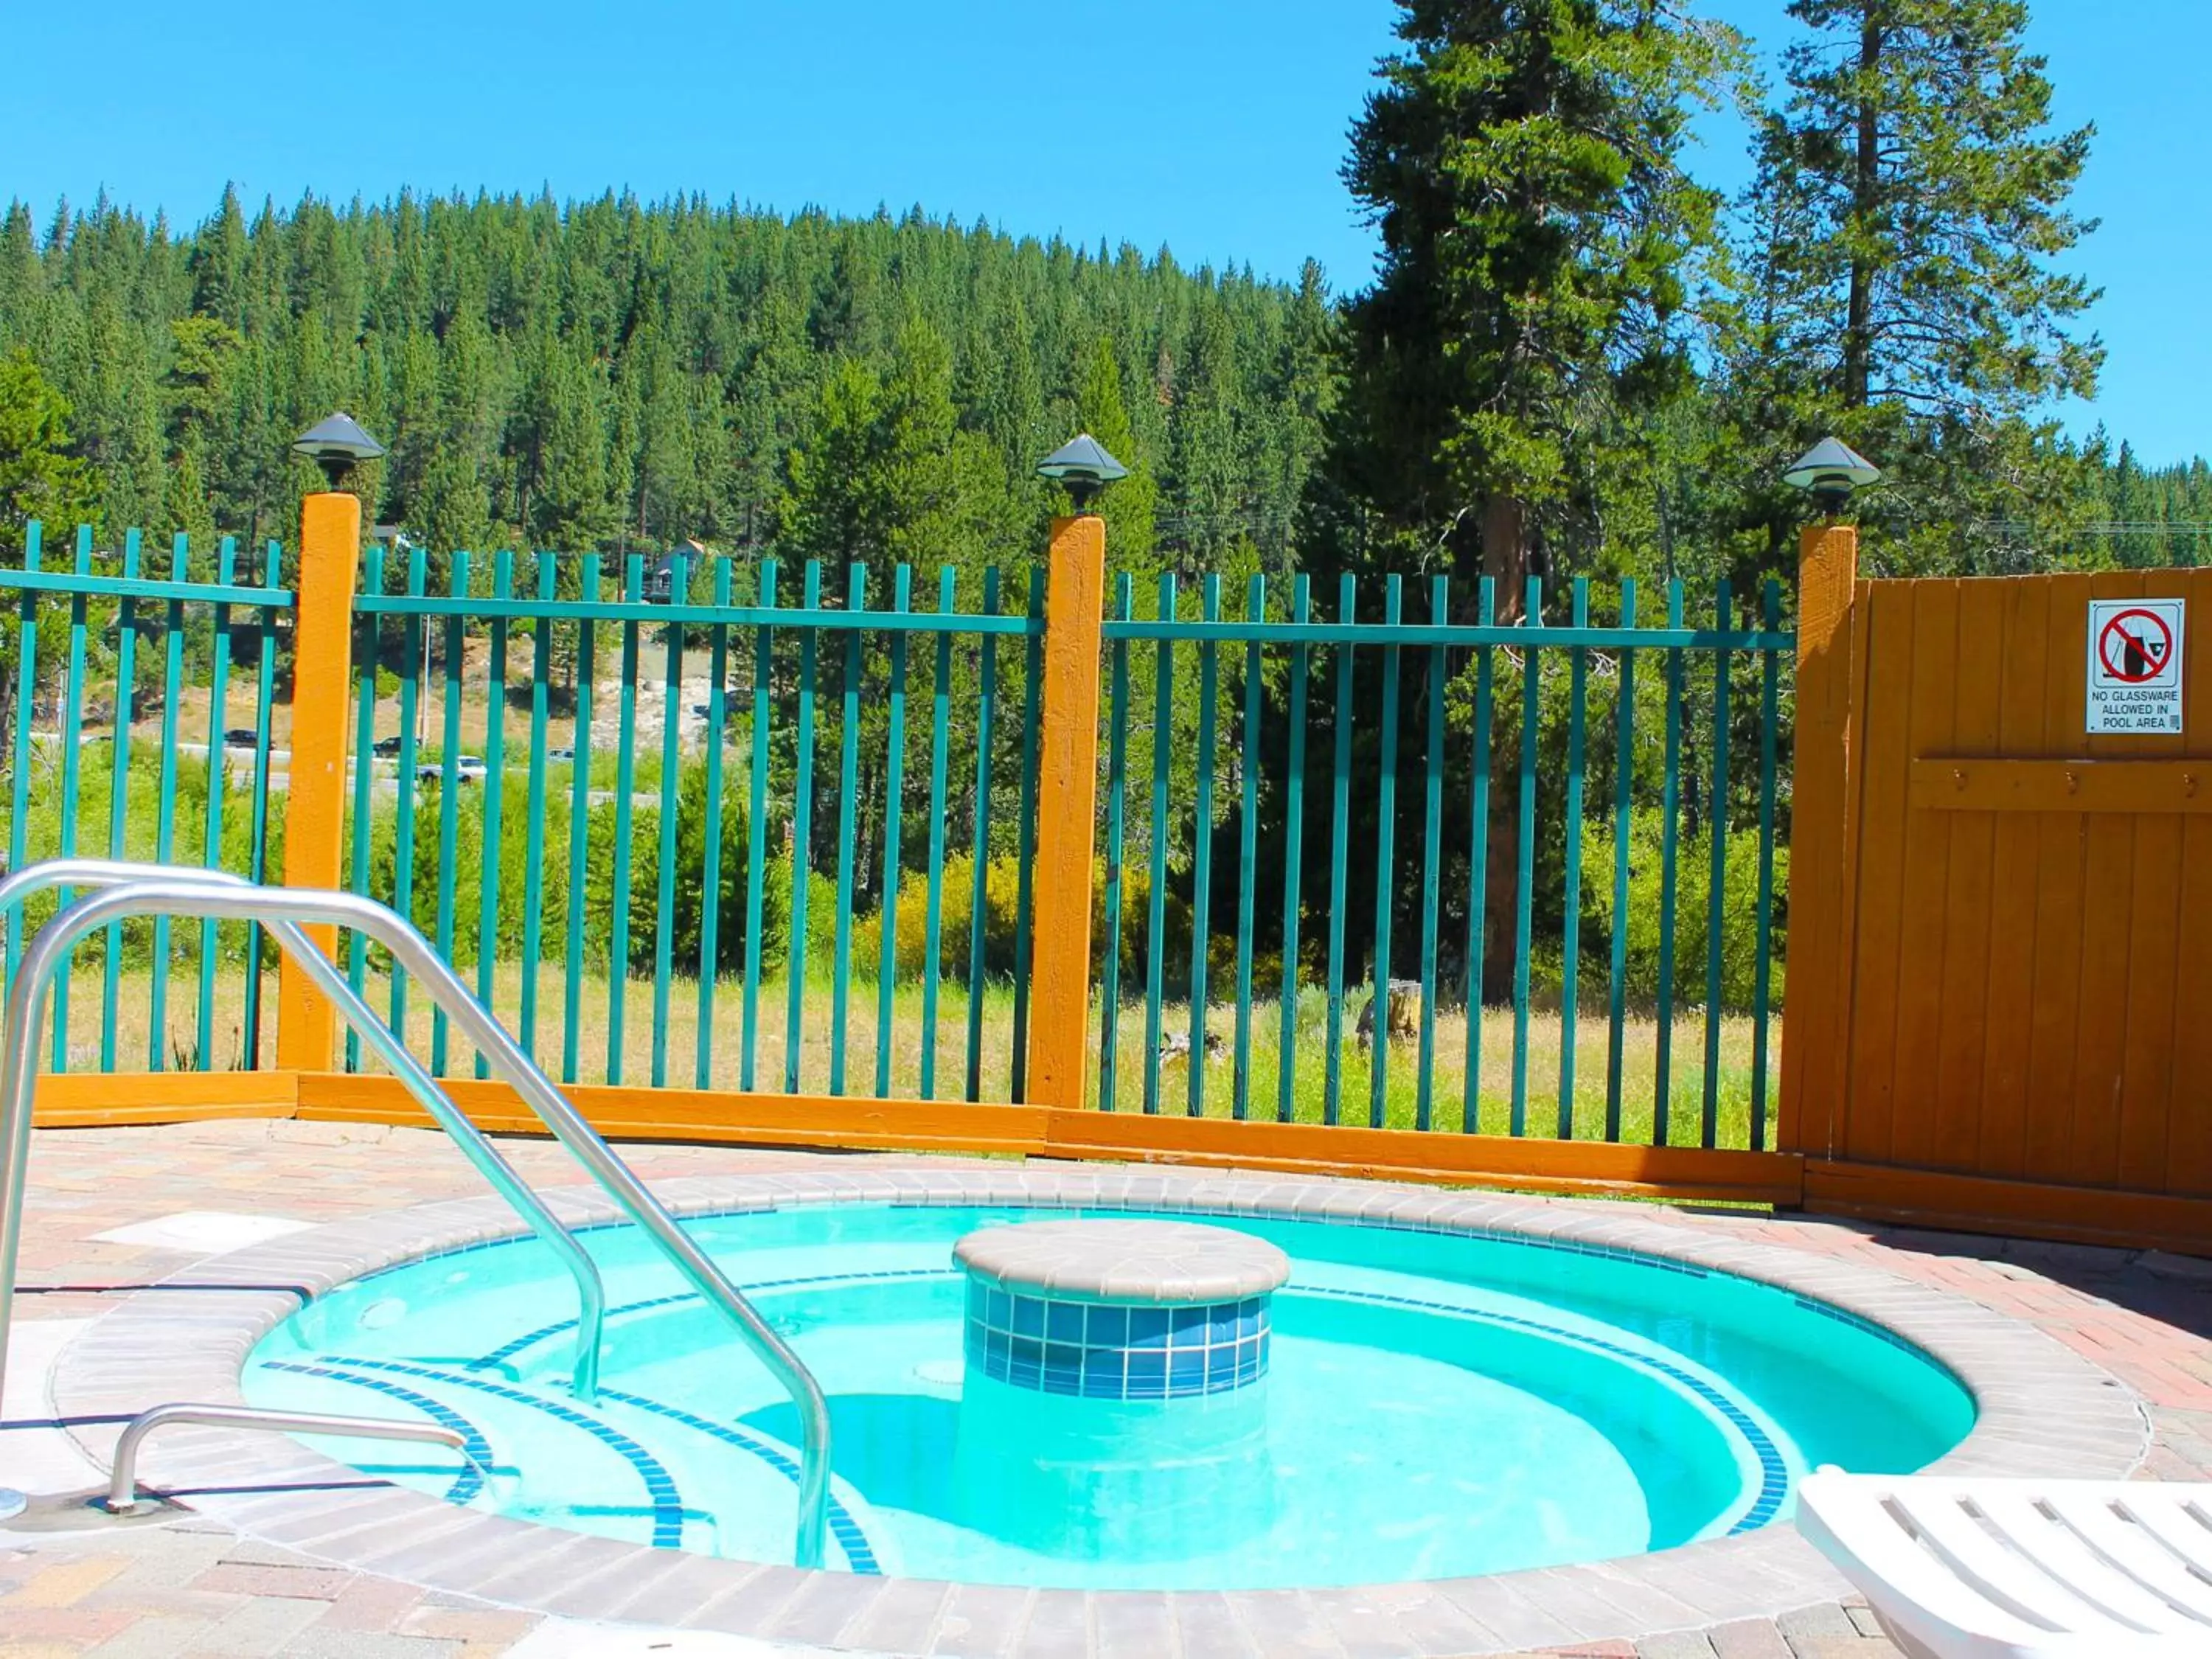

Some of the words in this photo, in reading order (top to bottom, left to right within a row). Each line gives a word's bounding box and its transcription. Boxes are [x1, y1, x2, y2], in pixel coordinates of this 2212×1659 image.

[2092, 691, 2107, 701] NO
[2112, 691, 2178, 701] GLASSWARE
[2102, 704, 2153, 714] ALLOWED
[2157, 704, 2168, 714] IN
[2104, 717, 2132, 728] POOL
[2136, 717, 2166, 728] AREA
